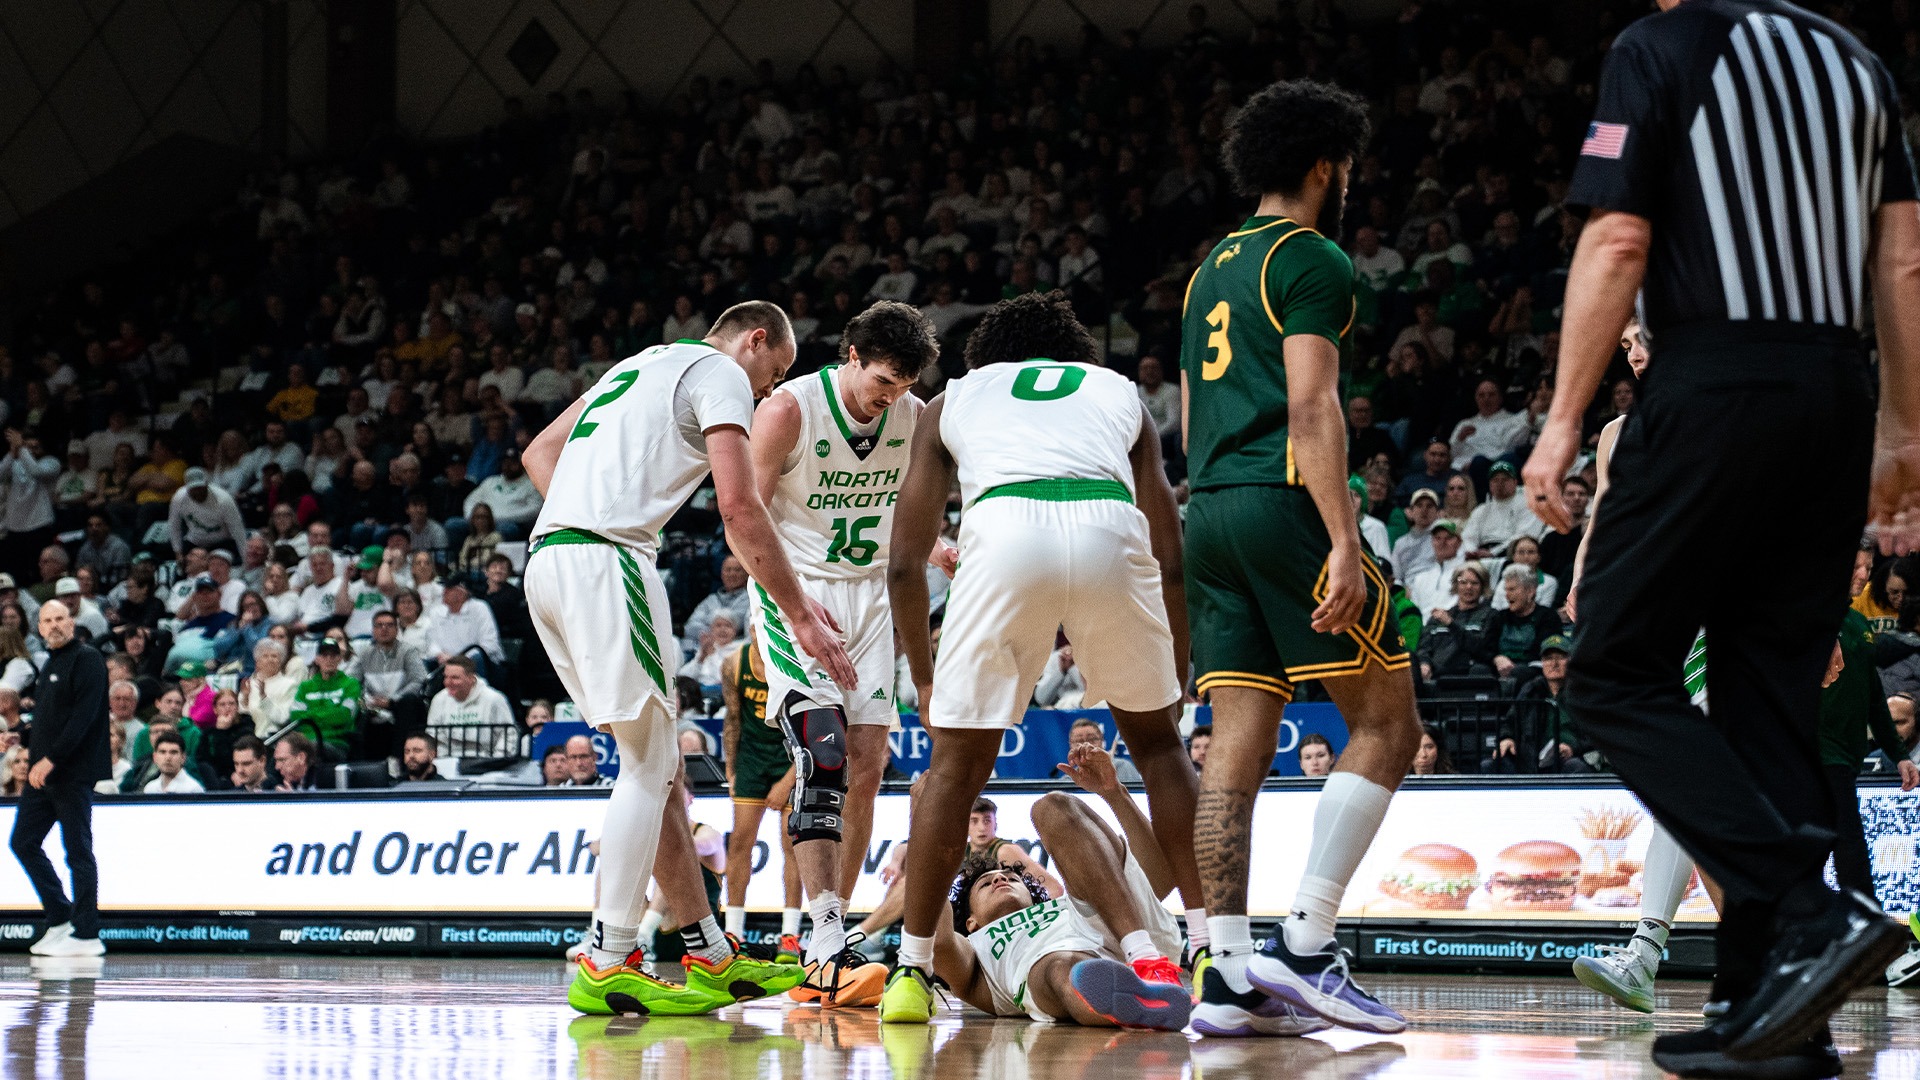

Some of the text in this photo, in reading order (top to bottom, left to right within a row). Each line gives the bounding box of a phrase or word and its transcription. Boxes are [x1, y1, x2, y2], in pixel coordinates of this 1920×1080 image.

[1202, 300, 1233, 381] 3
[1011, 365, 1087, 401] 0
[568, 369, 640, 443] 2
[816, 444, 830, 453] DM
[818, 468, 900, 490] NORTH
[825, 515, 882, 566] 16
[266, 830, 362, 875] and
[373, 830, 519, 875] Order
[99, 926, 250, 943] ommunity Credit Union
[279, 926, 416, 944] myFCCU.com/UND
[441, 927, 475, 943] First
[477, 928, 560, 946] Community
[1374, 937, 1420, 955] First
[1422, 939, 1539, 962] Community
[1540, 941, 1603, 960] Credit
